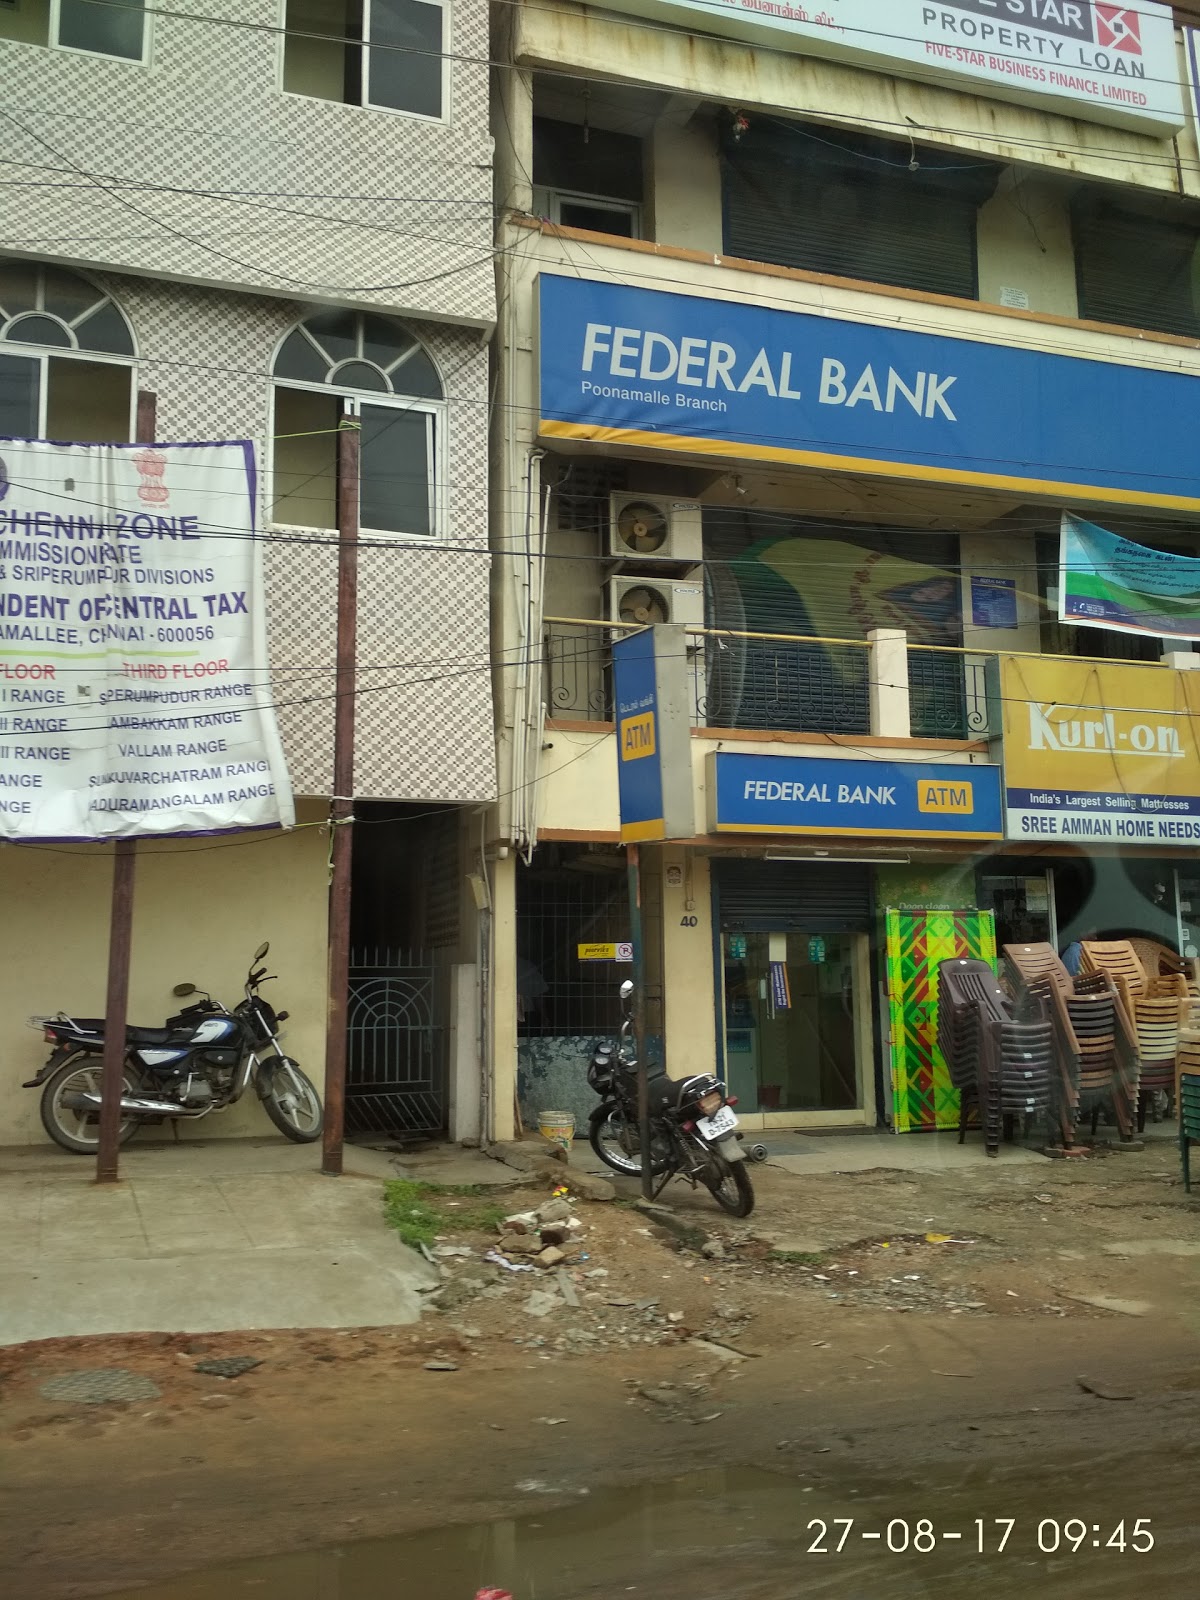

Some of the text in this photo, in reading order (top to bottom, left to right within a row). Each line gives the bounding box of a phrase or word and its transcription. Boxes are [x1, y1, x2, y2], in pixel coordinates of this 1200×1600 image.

[923, 7, 1145, 79] PROPERTY LOAN
[925, 40, 1147, 106] FIVE-STAR BUSINESS FINANCE LIMITED
[581, 322, 958, 421] FEDERAL BANK
[581, 380, 727, 413] Poonamalle Branch
[115, 513, 200, 541] ZONE
[135, 567, 215, 585] DIVISIONS
[203, 591, 249, 618] TAX
[157, 625, 214, 643] 600056
[122, 658, 230, 680] THIRD FLOOR
[11, 689, 66, 704] RANGE
[204, 683, 253, 702] RANGE
[13, 718, 68, 733] RANGE
[194, 710, 243, 729] RANGE
[1026, 701, 1186, 758] Kurl-on
[626, 722, 652, 752] ATM
[15, 746, 71, 761] RANGE
[118, 738, 228, 758] VALLAM RANGE
[228, 782, 277, 803] RANGE
[744, 780, 897, 806] FEDERAL BANK
[925, 787, 967, 807] ATM
[1030, 793, 1190, 811] India's Largest Selling Mattresses
[1021, 815, 1200, 839] SREE AMMAN HOME NEEDS
[680, 915, 698, 928] 40
